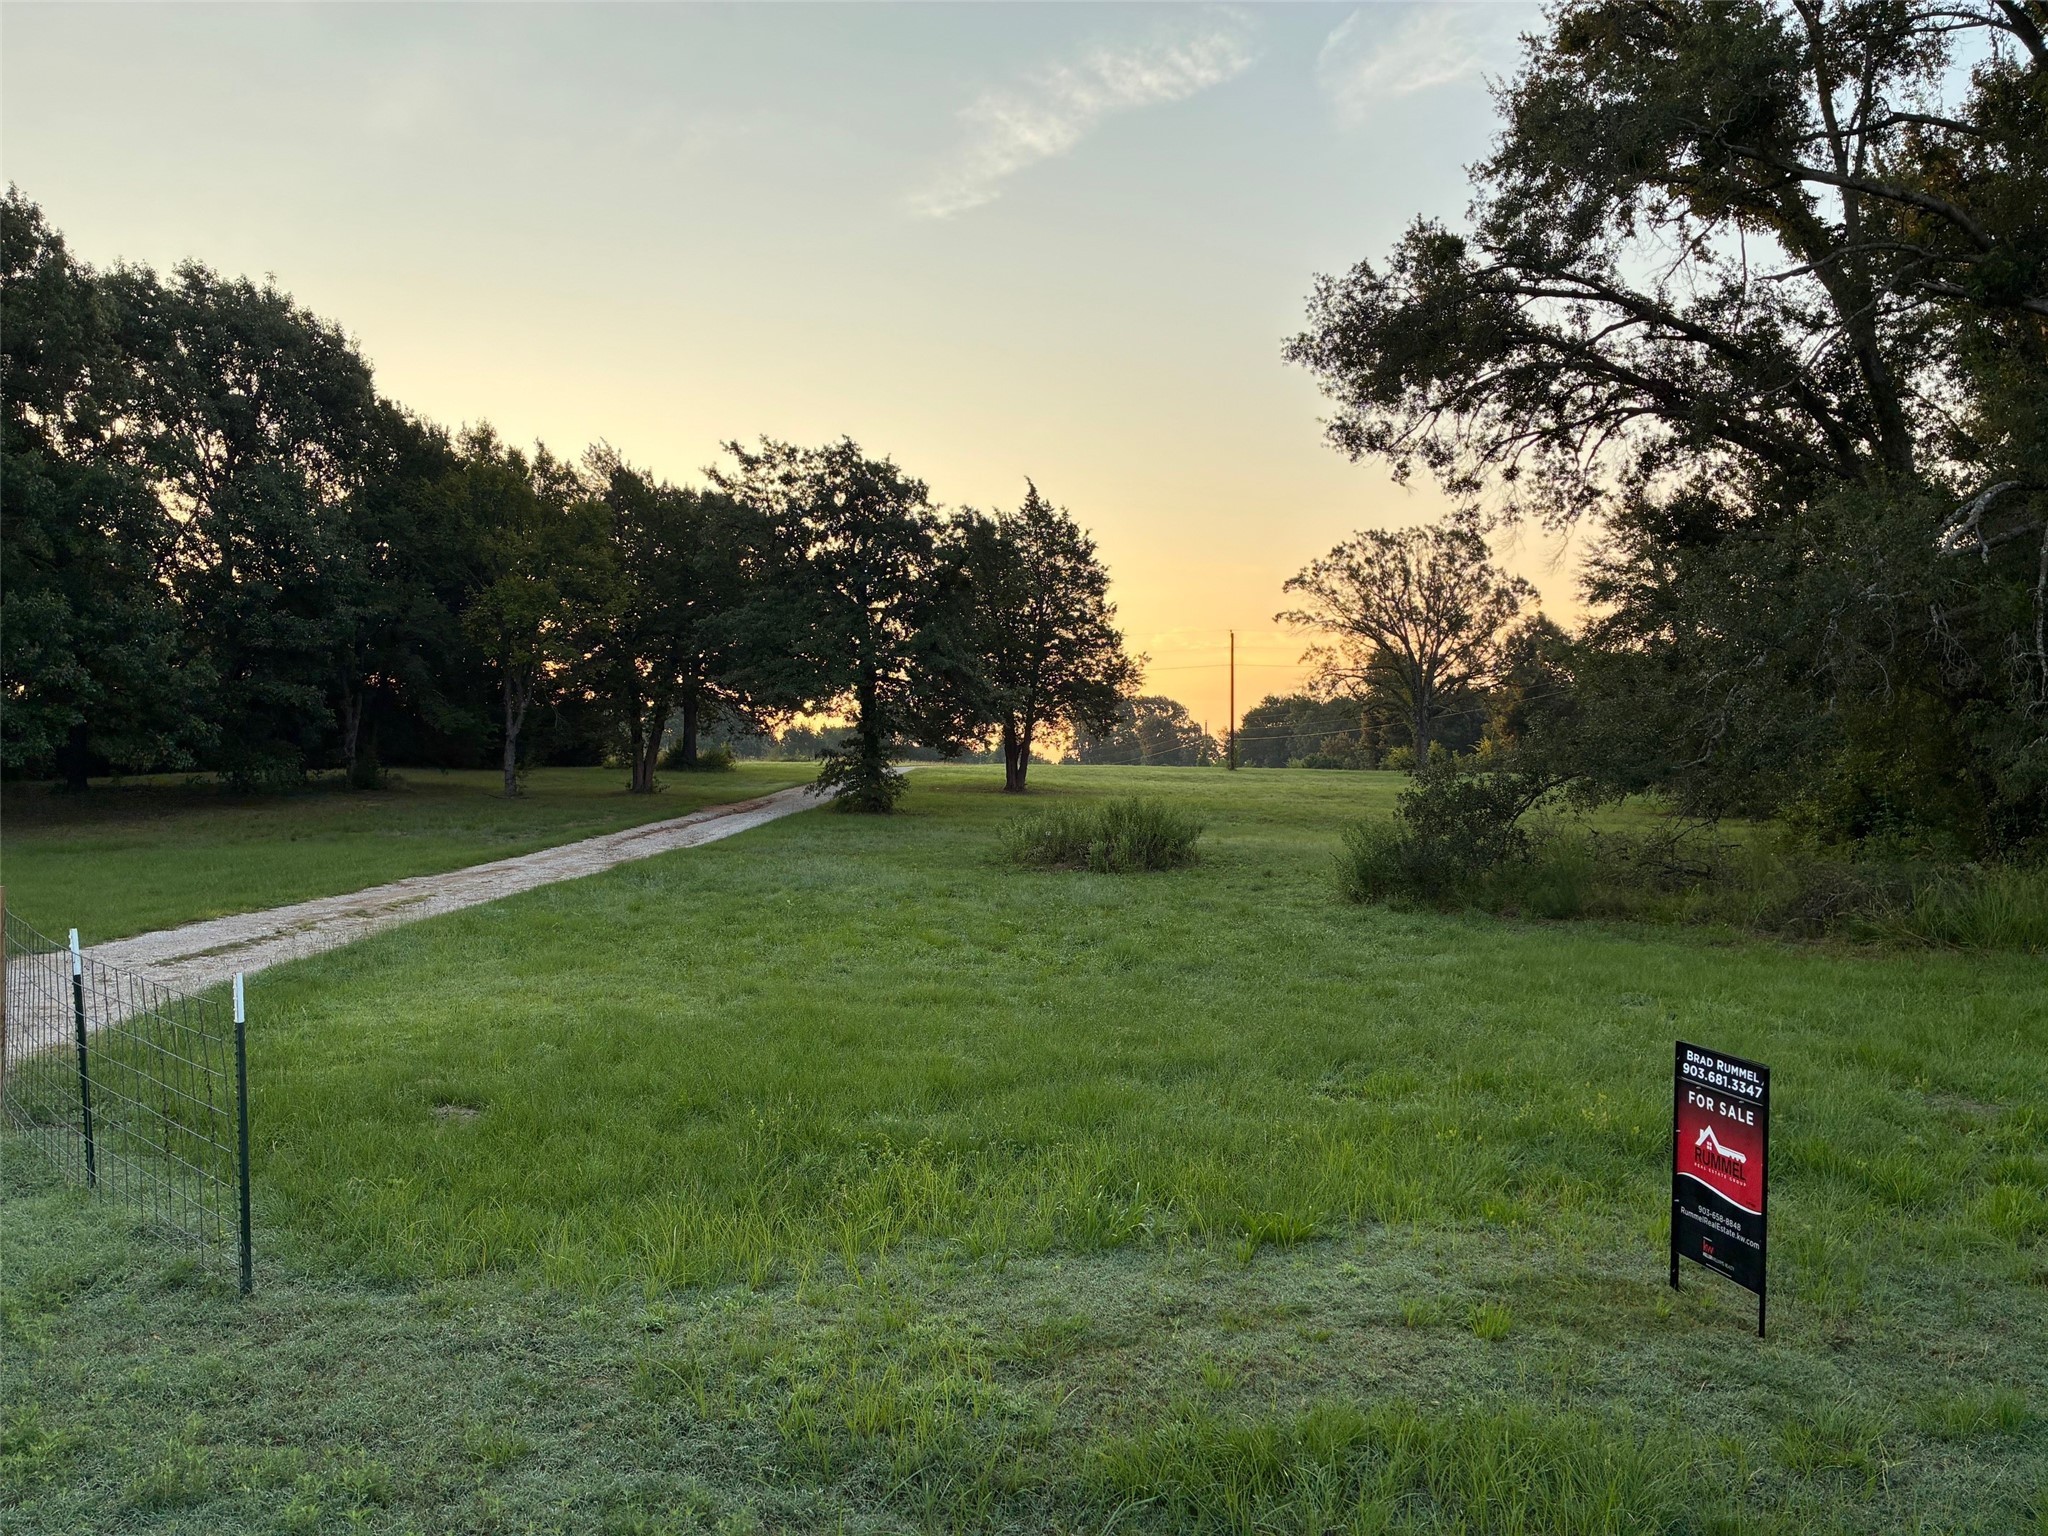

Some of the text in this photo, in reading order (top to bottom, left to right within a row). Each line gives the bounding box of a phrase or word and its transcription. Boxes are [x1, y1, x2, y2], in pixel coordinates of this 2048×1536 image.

[1682, 1063, 1763, 1098] 903.681.3347
[1687, 1050, 1759, 1083] BRAD RUMMEL
[1688, 1090, 1754, 1126] FOR SALE
[1694, 1145, 1746, 1182] RUMMEL
[1680, 1206, 1760, 1250] RummelRealEstate.kw.com
